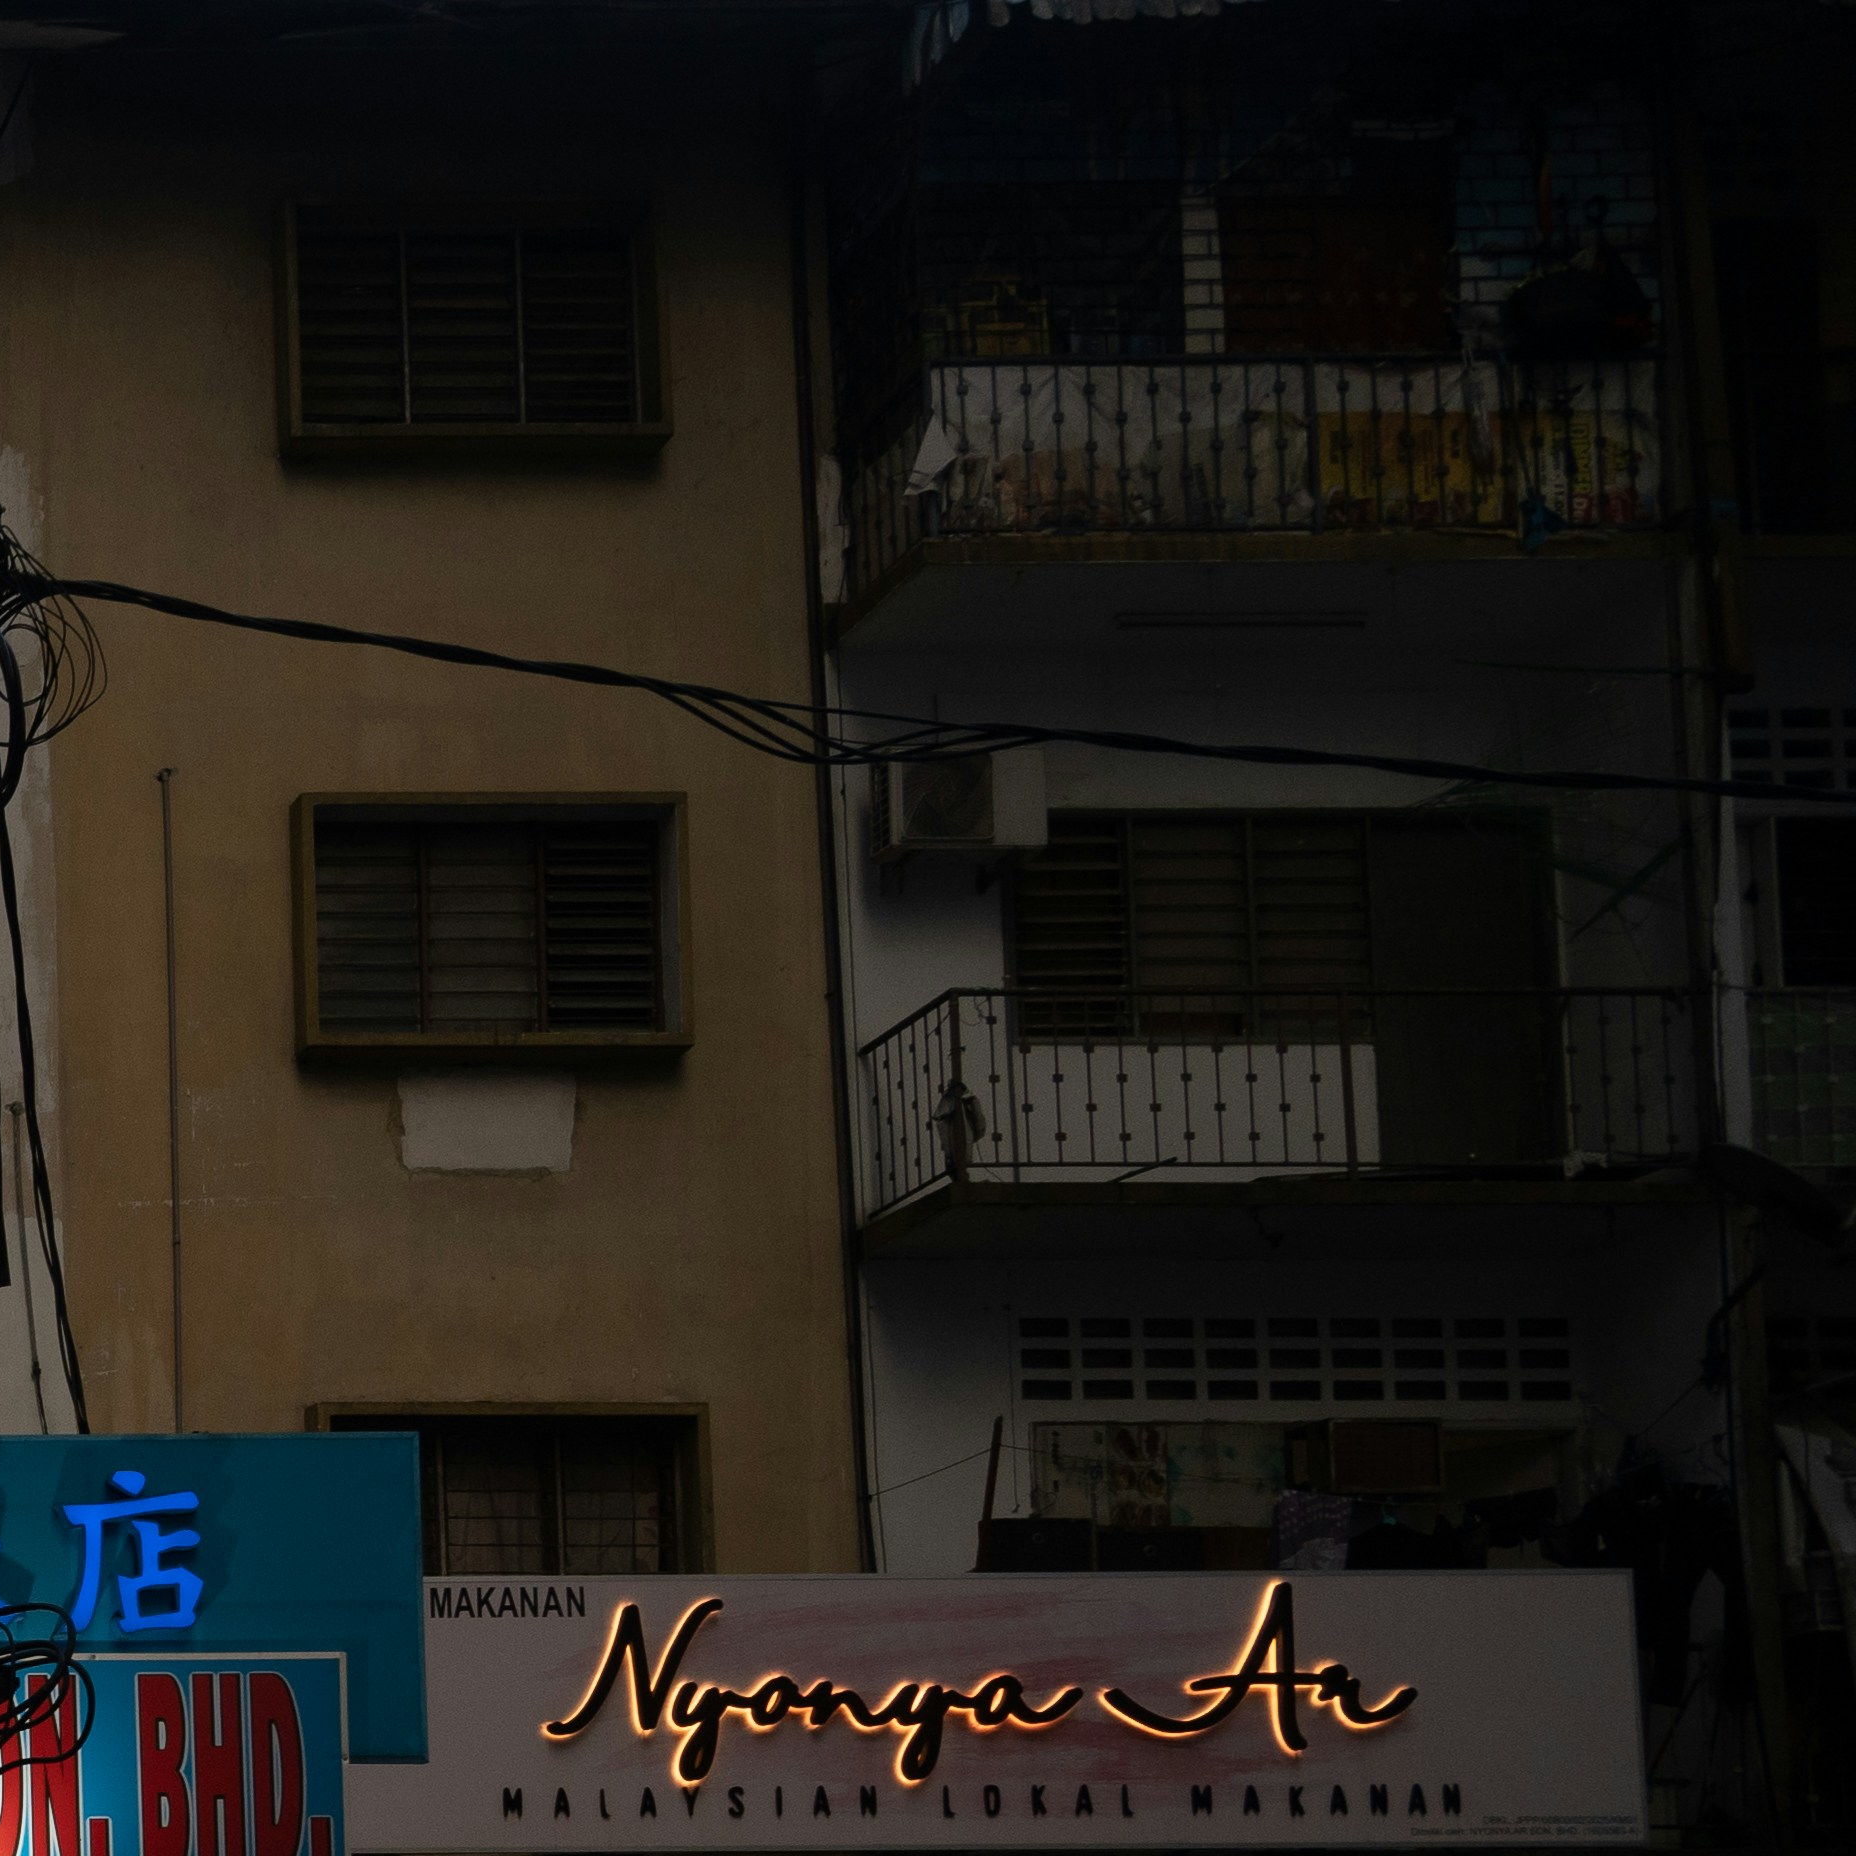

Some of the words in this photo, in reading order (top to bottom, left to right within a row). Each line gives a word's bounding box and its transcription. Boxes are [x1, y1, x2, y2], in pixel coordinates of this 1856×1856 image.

[429, 1586, 586, 1619] MAKANAN
[540, 1595, 1084, 1785] Nyonya
[500, 1783, 881, 1821] MALAYSIAN
[941, 1782, 1137, 1820] LOKAL
[1190, 1781, 1465, 1819] MAKANAN
